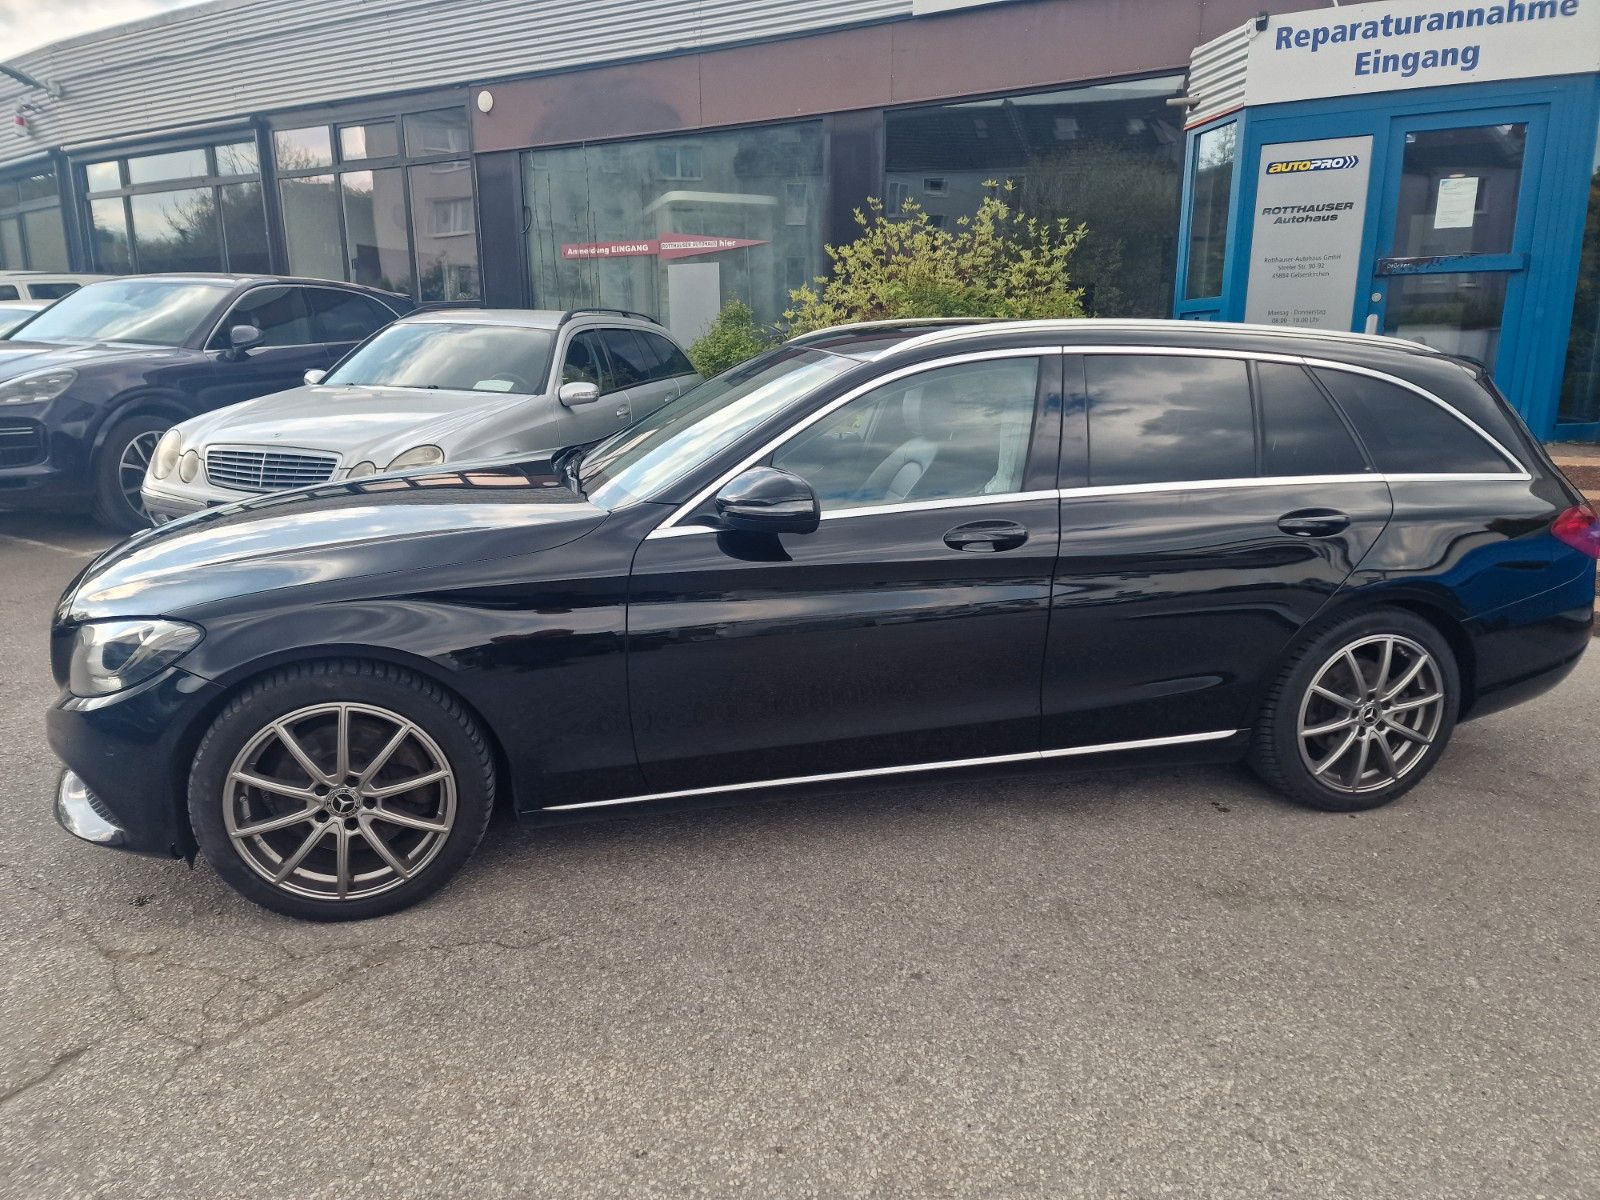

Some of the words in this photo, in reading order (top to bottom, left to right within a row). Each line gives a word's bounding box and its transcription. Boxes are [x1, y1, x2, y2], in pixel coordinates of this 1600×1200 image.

[1275, 0, 1580, 52] Reparaturannahme
[1354, 45, 1481, 78] Eingang
[1262, 202, 1354, 216] ROTTHAUSER
[1273, 214, 1339, 225] Autohaus
[611, 244, 649, 253] EINGANG
